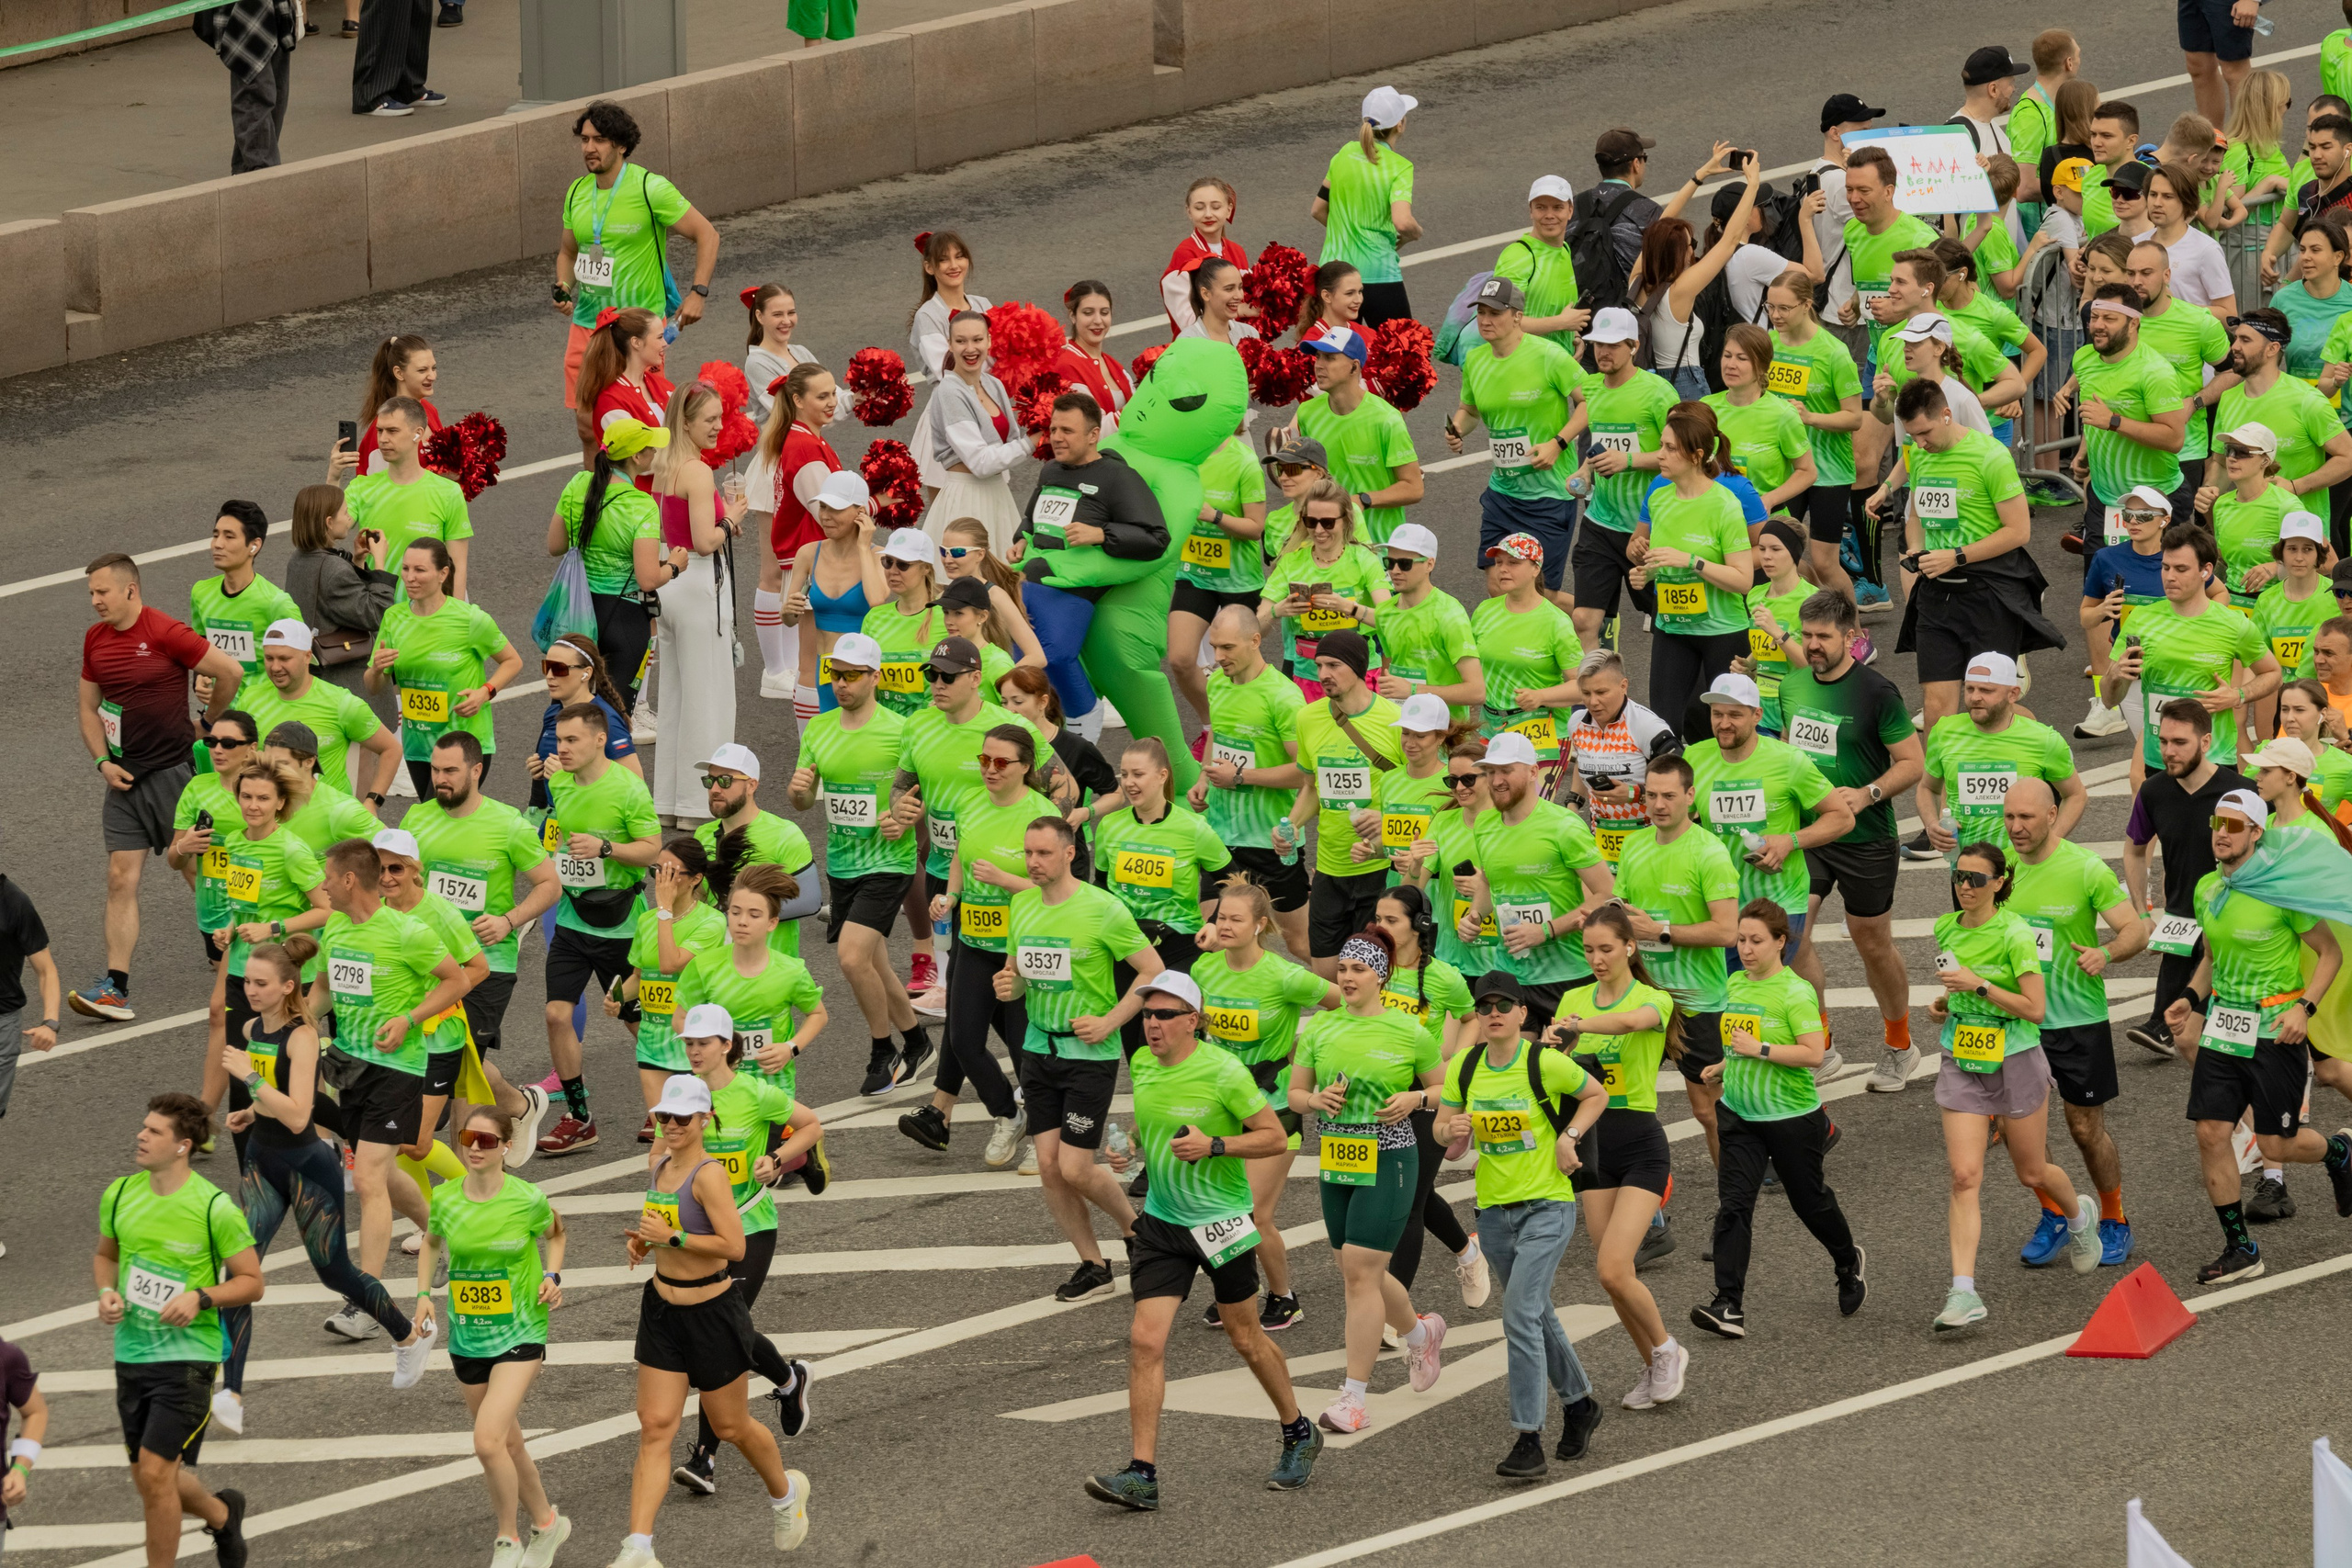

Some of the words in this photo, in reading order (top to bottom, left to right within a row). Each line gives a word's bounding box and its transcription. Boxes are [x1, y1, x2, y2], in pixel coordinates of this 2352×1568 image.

[1895, 155, 1962, 176] АМА
[1769, 367, 1802, 385] 6558
[1493, 442, 1525, 458] 5978
[1041, 500, 1069, 516] 1877
[1919, 491, 1950, 508] 4993
[1189, 539, 1223, 558] 6128
[1183, 563, 1191, 571] B
[1664, 589, 1698, 604] 1856
[213, 634, 246, 651] 2711
[2280, 642, 2305, 658] 27
[881, 668, 914, 682] 1910
[409, 694, 440, 711] 6336
[1513, 724, 1551, 739] 434
[1795, 722, 1828, 743] 2206
[1797, 739, 1826, 750] АЛЕКСАНДР
[1326, 773, 1363, 788] 1255
[1966, 777, 2009, 794] 5998
[831, 798, 867, 817] 5432
[1716, 795, 1756, 813] 1717
[1964, 806, 1971, 815] B
[549, 825, 560, 840] 38
[832, 824, 837, 833] B
[932, 823, 956, 840] 541
[1387, 819, 1421, 836] 5026
[1716, 825, 1723, 833] B
[1601, 835, 1624, 851] 355
[211, 852, 228, 867] 15
[560, 859, 595, 876] 5053
[1123, 858, 1165, 877] 4805
[206, 878, 211, 887] B
[229, 871, 254, 890] 3009
[437, 877, 478, 899] 1574
[1121, 883, 1128, 892] E
[966, 909, 1002, 927] 1508
[1516, 909, 1543, 925] 750
[1024, 952, 1062, 969] 3537
[334, 964, 364, 984] 2798
[641, 987, 673, 1004] 1692
[1211, 1012, 1250, 1031] 4840
[2216, 1012, 2251, 1033] 5025
[743, 1034, 763, 1051] 18
[1959, 1030, 1996, 1049] 2368
[1067, 1112, 1094, 1127] Vintage
[1481, 1116, 1522, 1134] 1233
[1329, 1142, 1368, 1161] 1888
[718, 1157, 739, 1174] 70
[1324, 1171, 1330, 1181] B
[1219, 1229, 1241, 1245] МИХАИЛ
[1216, 1254, 1225, 1264] B
[134, 1275, 175, 1303] 3617
[459, 1286, 502, 1303] 6383
[459, 1315, 466, 1325] B
